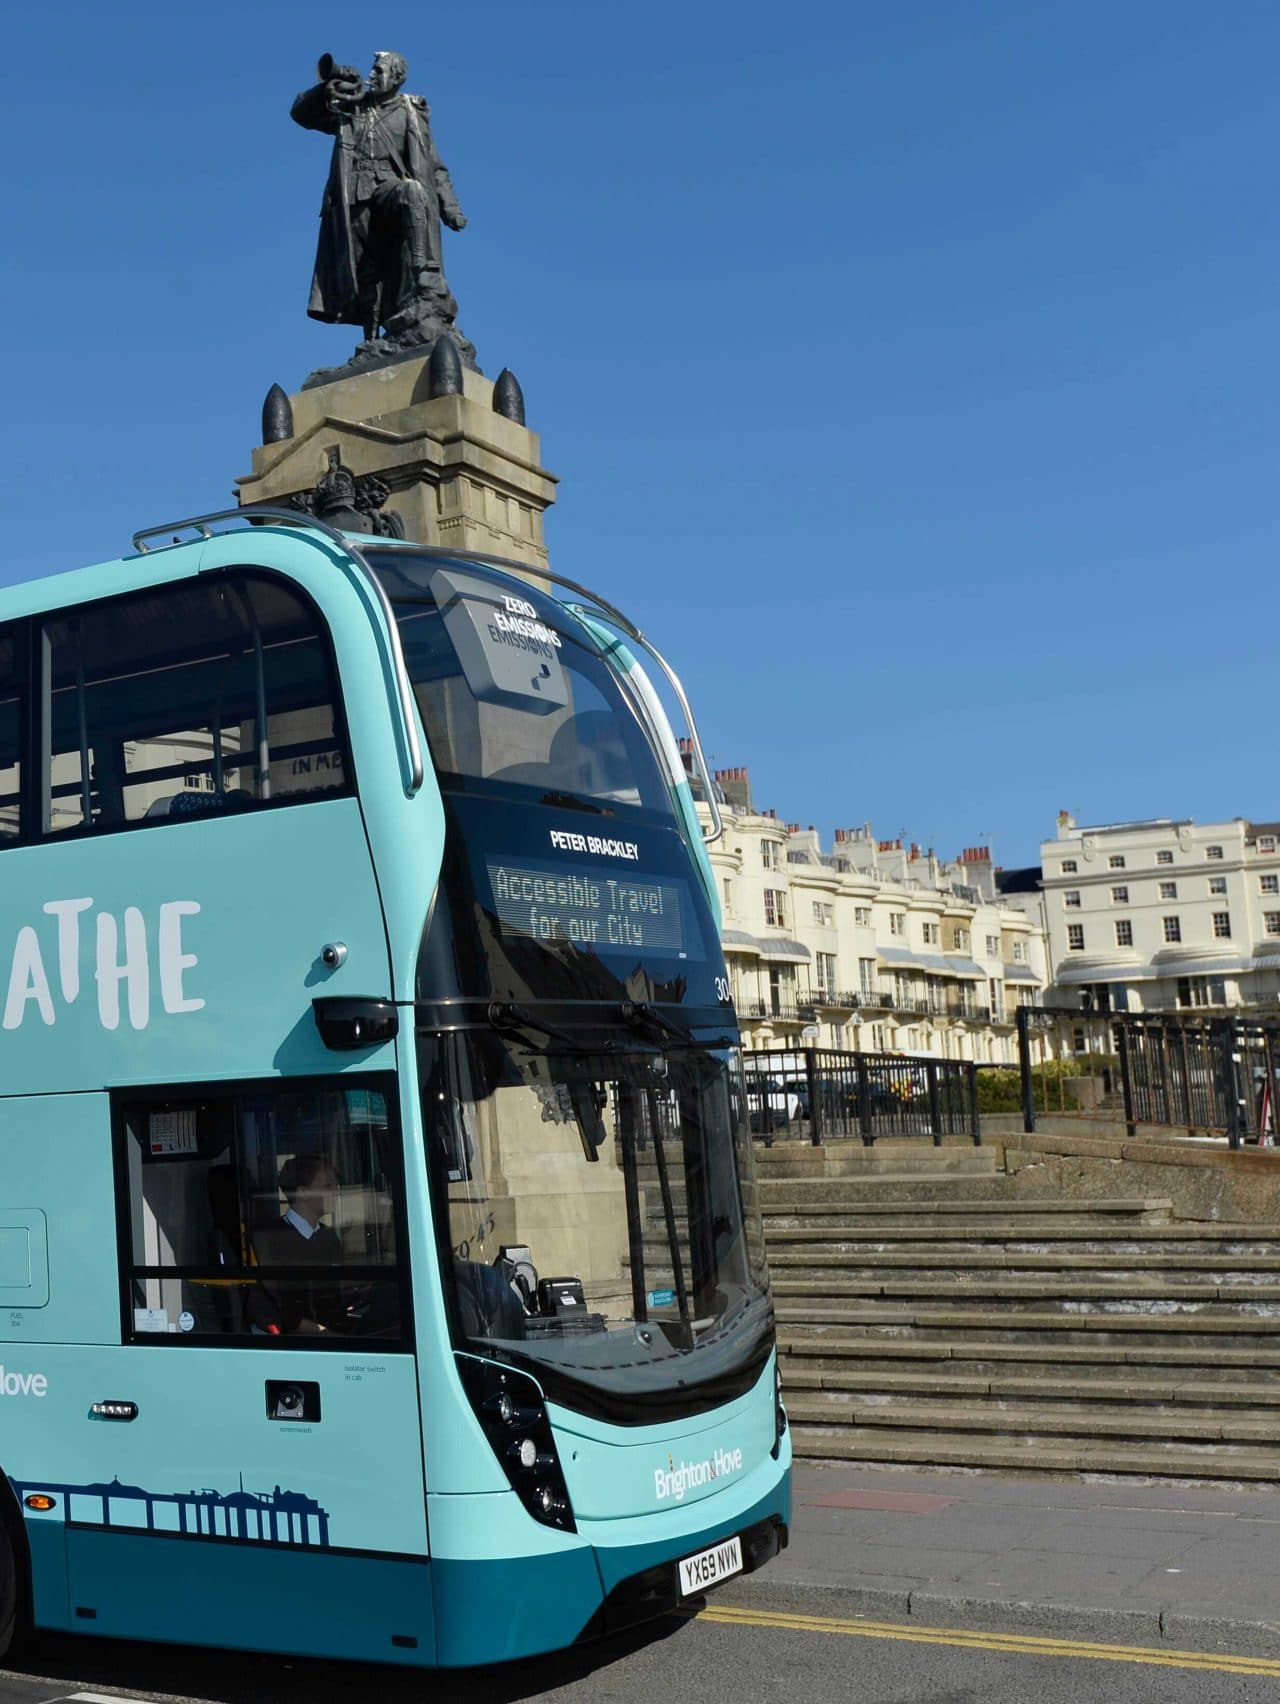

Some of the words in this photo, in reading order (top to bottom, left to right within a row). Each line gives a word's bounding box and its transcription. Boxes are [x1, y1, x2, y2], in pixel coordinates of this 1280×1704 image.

[501, 595, 536, 618] ZERO
[494, 612, 562, 648] EMISSIONS
[550, 830, 587, 852] PETER
[587, 836, 639, 861] BRACKLEY
[496, 866, 600, 908] Accessible
[607, 880, 664, 914] Travel
[529, 907, 558, 939] for
[569, 915, 600, 942] our
[607, 914, 643, 946] City
[685, 1553, 716, 1588] YX69
[717, 1543, 738, 1573] NVN
